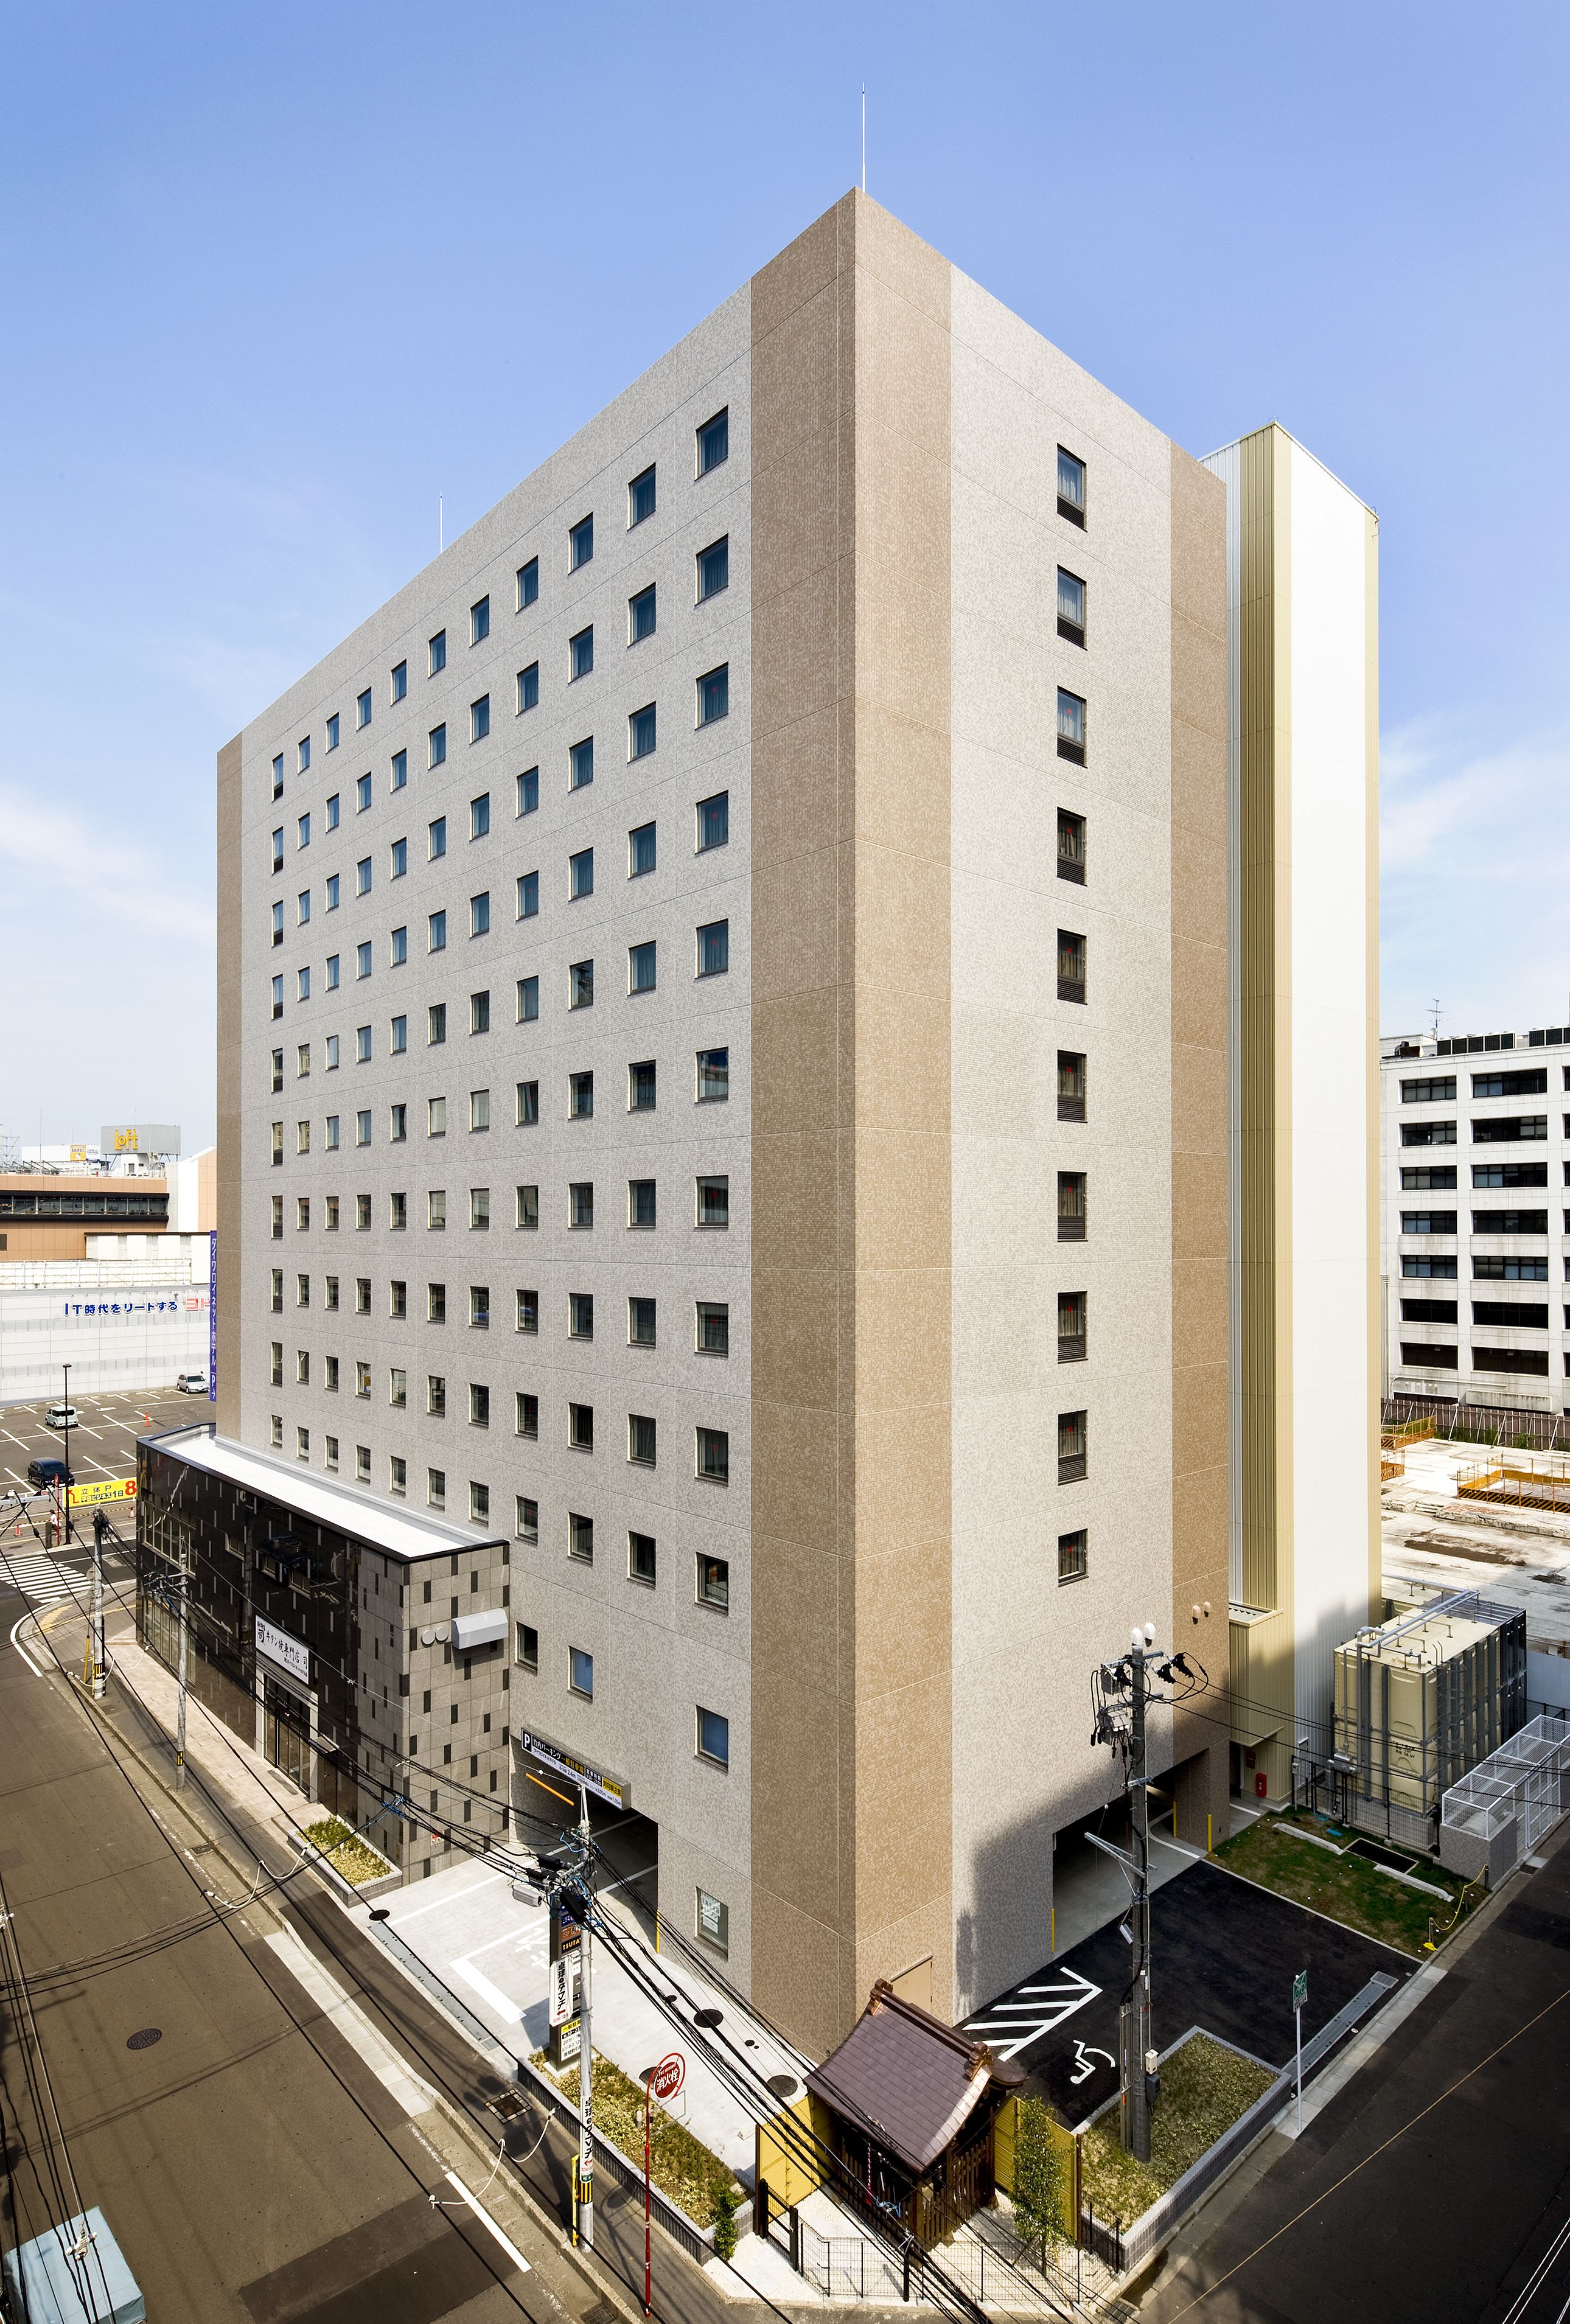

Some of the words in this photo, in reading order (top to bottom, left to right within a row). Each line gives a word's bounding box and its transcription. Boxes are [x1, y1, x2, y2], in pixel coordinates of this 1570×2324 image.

[524, 1733, 531, 1748] P
[562, 1937, 581, 1950] TSUTA
[657, 2068, 679, 2093] 消火栓
